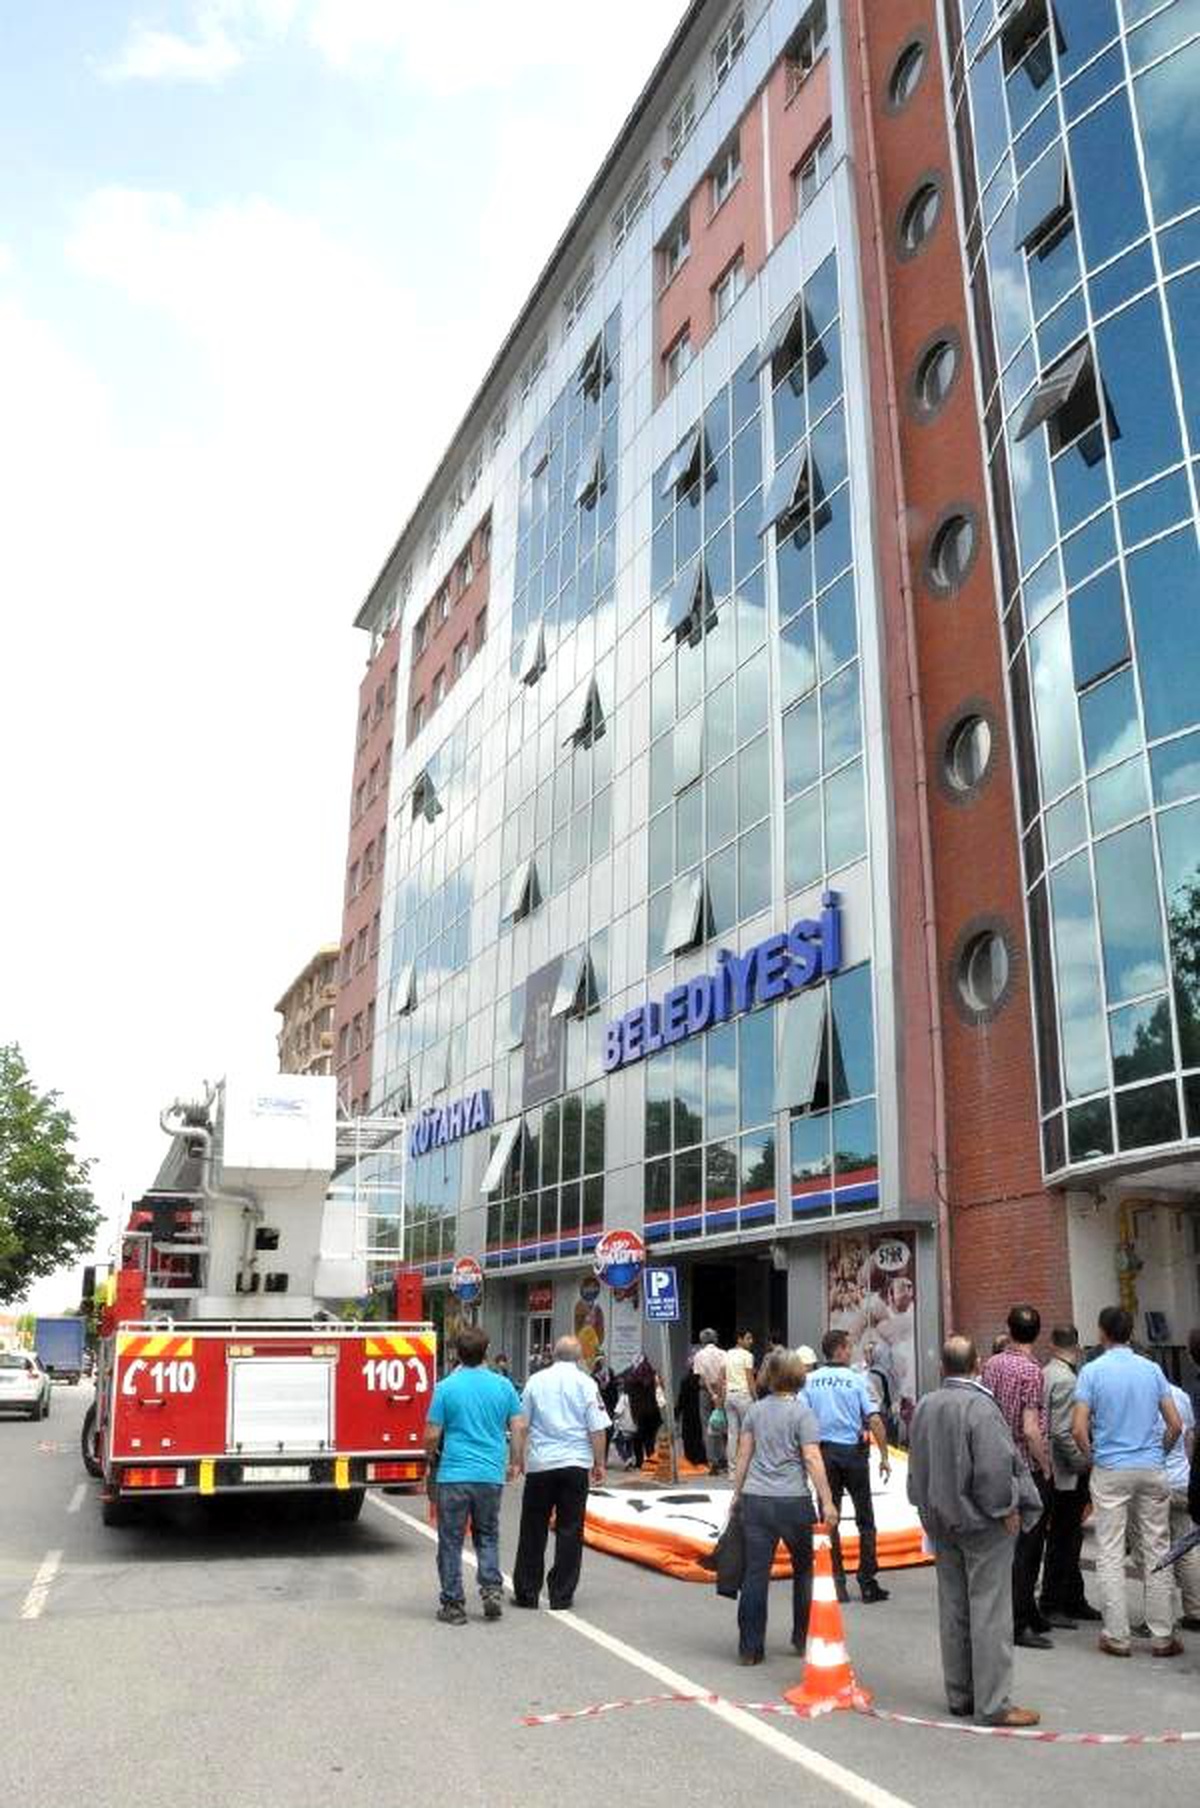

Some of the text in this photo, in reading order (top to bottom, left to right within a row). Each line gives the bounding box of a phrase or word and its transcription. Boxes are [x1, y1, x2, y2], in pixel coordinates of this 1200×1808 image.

[601, 890, 842, 1072] BELEDİYESİ
[409, 1089, 492, 1159] KÜTAHYA
[651, 1271, 670, 1297] P
[150, 1360, 196, 1393] 110
[362, 1359, 405, 1391] 110
